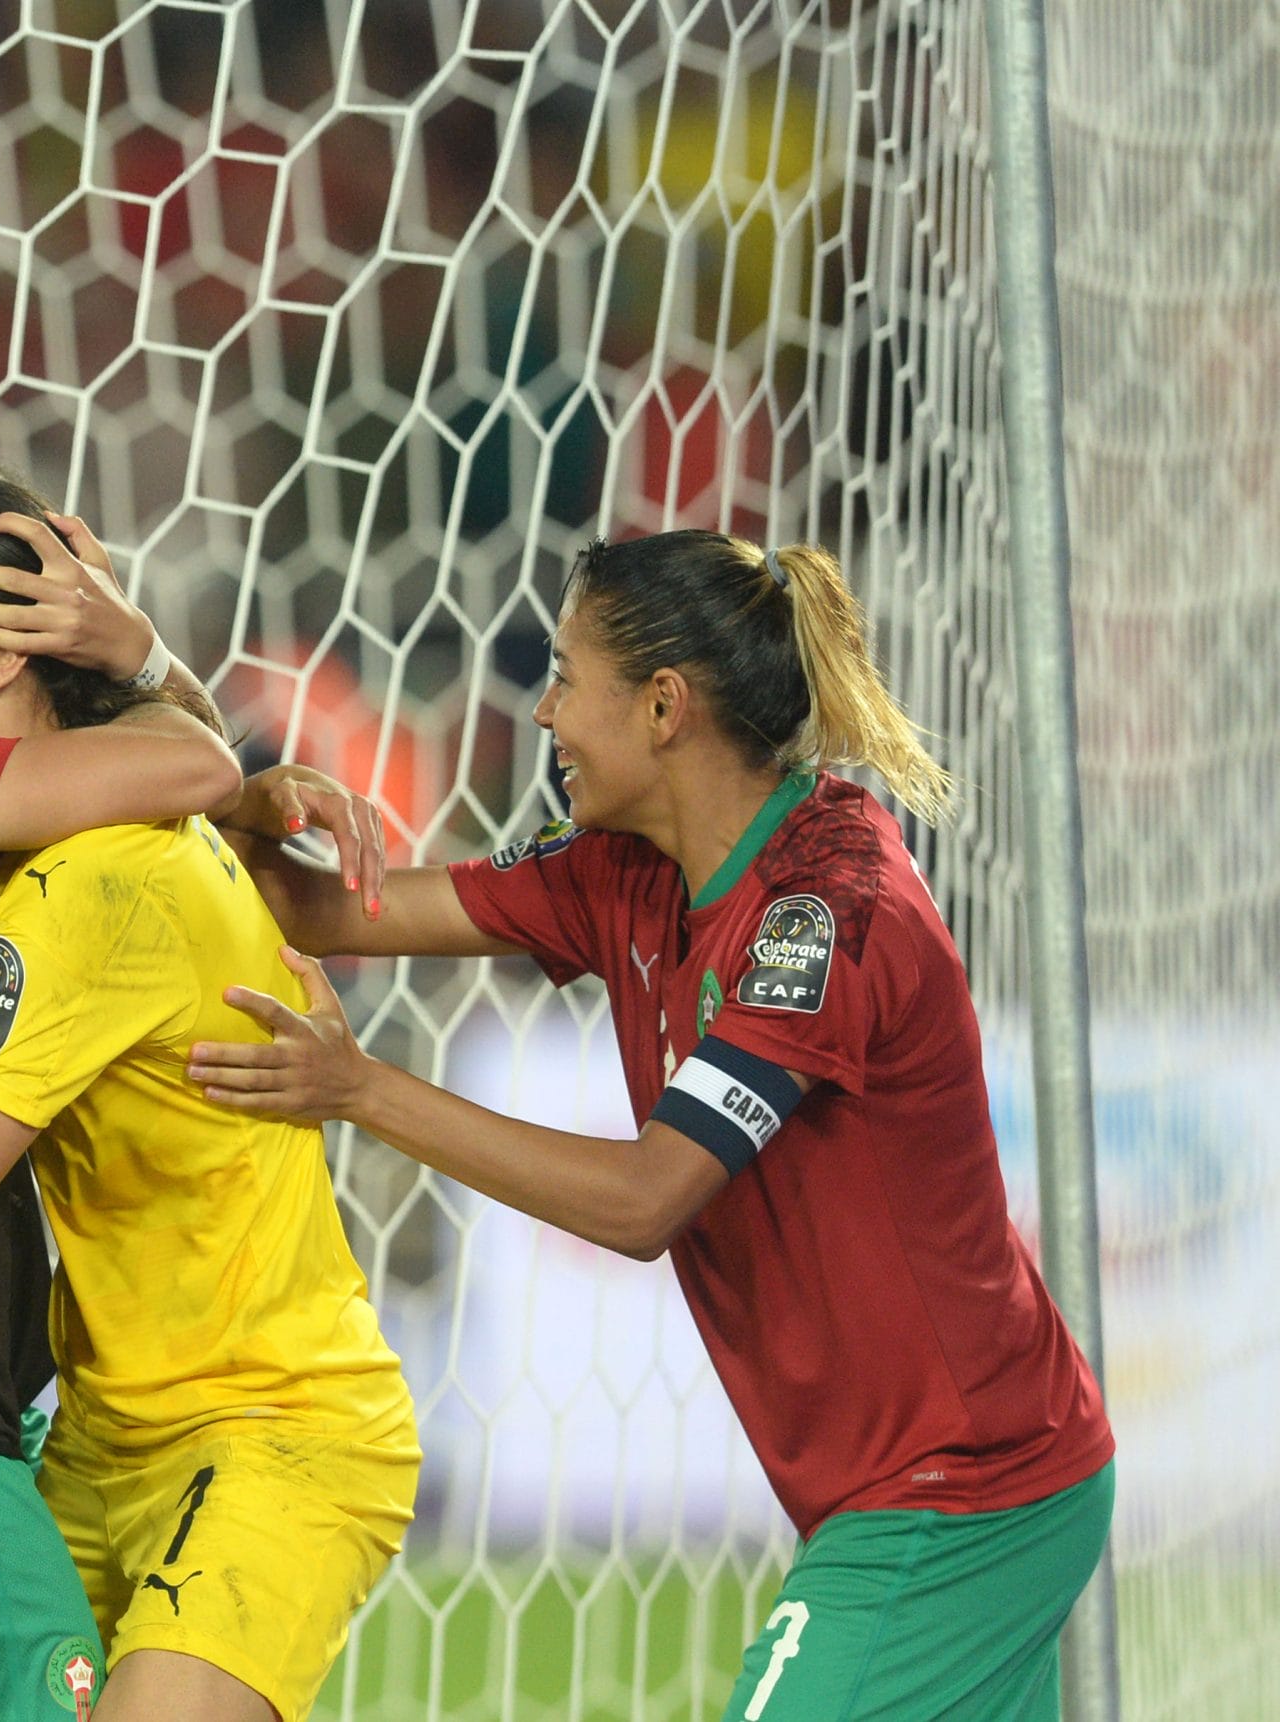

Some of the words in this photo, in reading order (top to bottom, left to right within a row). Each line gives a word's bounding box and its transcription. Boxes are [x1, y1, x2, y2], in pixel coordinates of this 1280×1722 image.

[753, 938, 828, 960] Celebrate
[753, 981, 809, 999] CAF
[744, 1600, 810, 1722] 7
